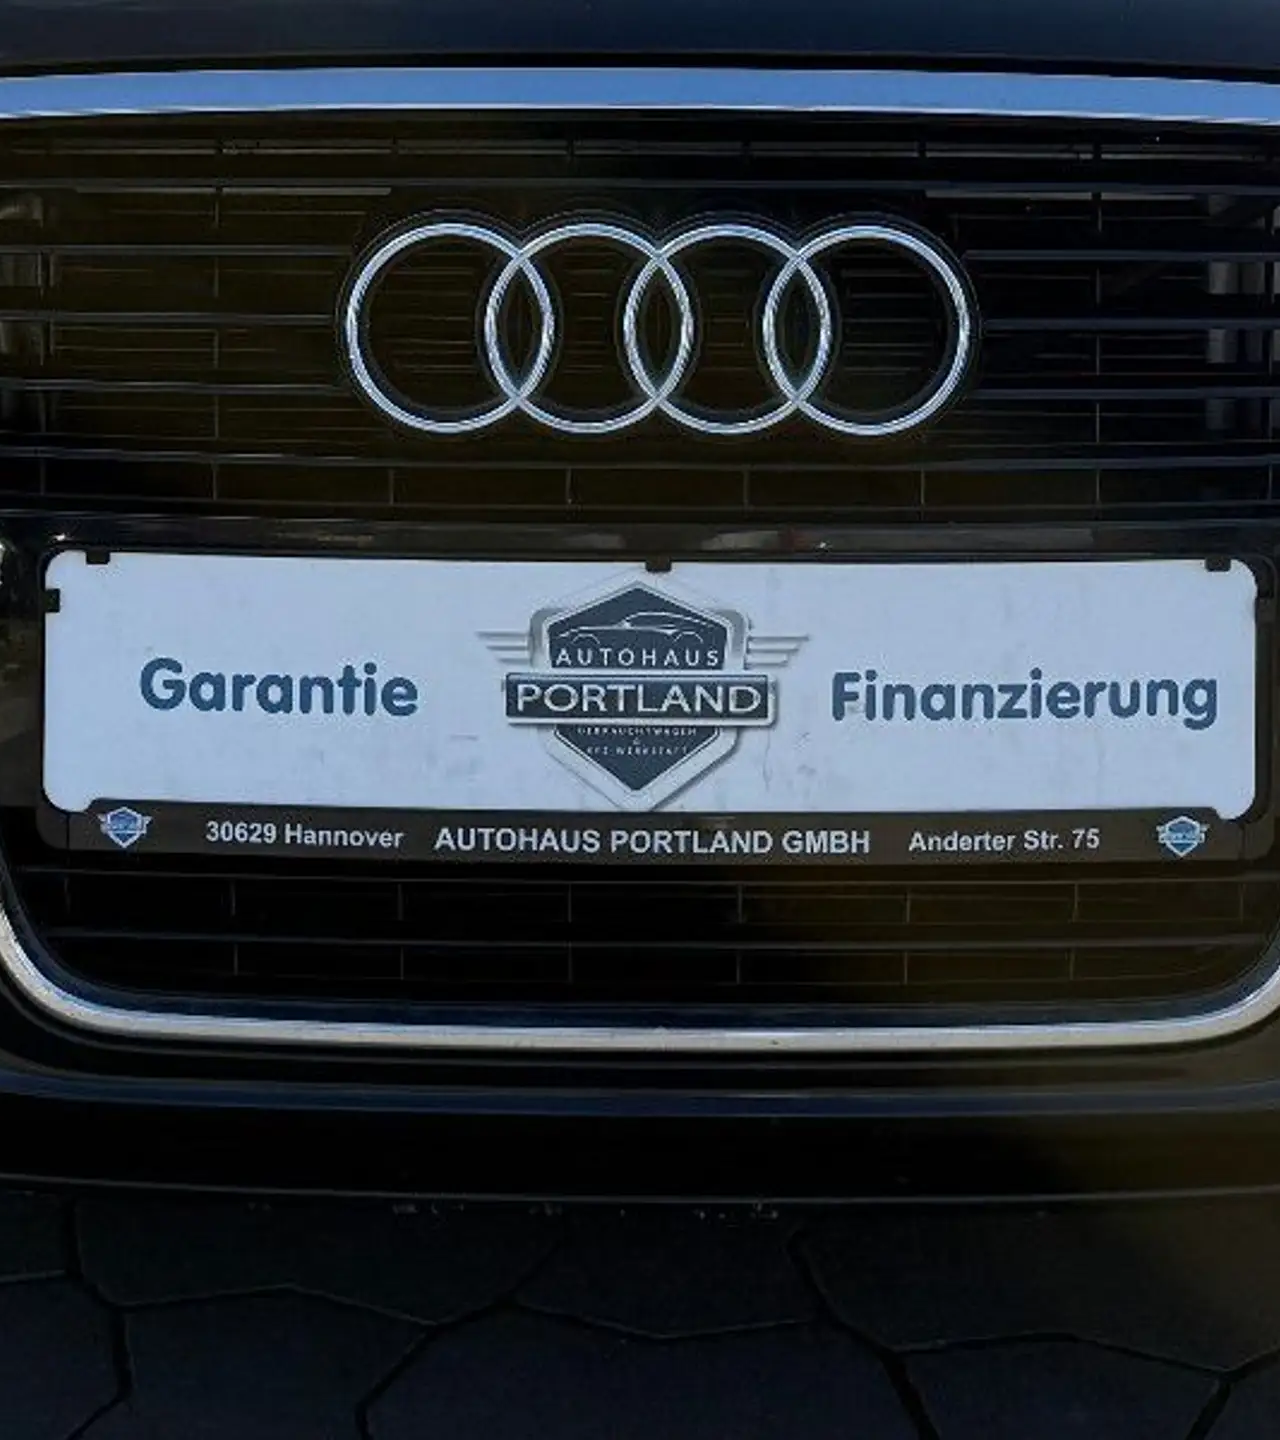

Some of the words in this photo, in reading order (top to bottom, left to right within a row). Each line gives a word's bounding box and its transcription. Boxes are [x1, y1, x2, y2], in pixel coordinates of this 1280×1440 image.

[555, 647, 719, 667] AUTOHAUS
[139, 656, 419, 717] Garantie
[517, 683, 762, 714] PORTLAND
[831, 667, 1218, 731] Finanzierung
[205, 820, 277, 845] 30629
[284, 825, 404, 849] Hannover
[434, 826, 602, 853] AUTOHAUS
[611, 829, 772, 854] PORTLAND
[782, 829, 871, 855] GMBH
[908, 830, 1017, 853] Anderter
[1023, 829, 1065, 851] Str.
[1071, 828, 1101, 851] 75
